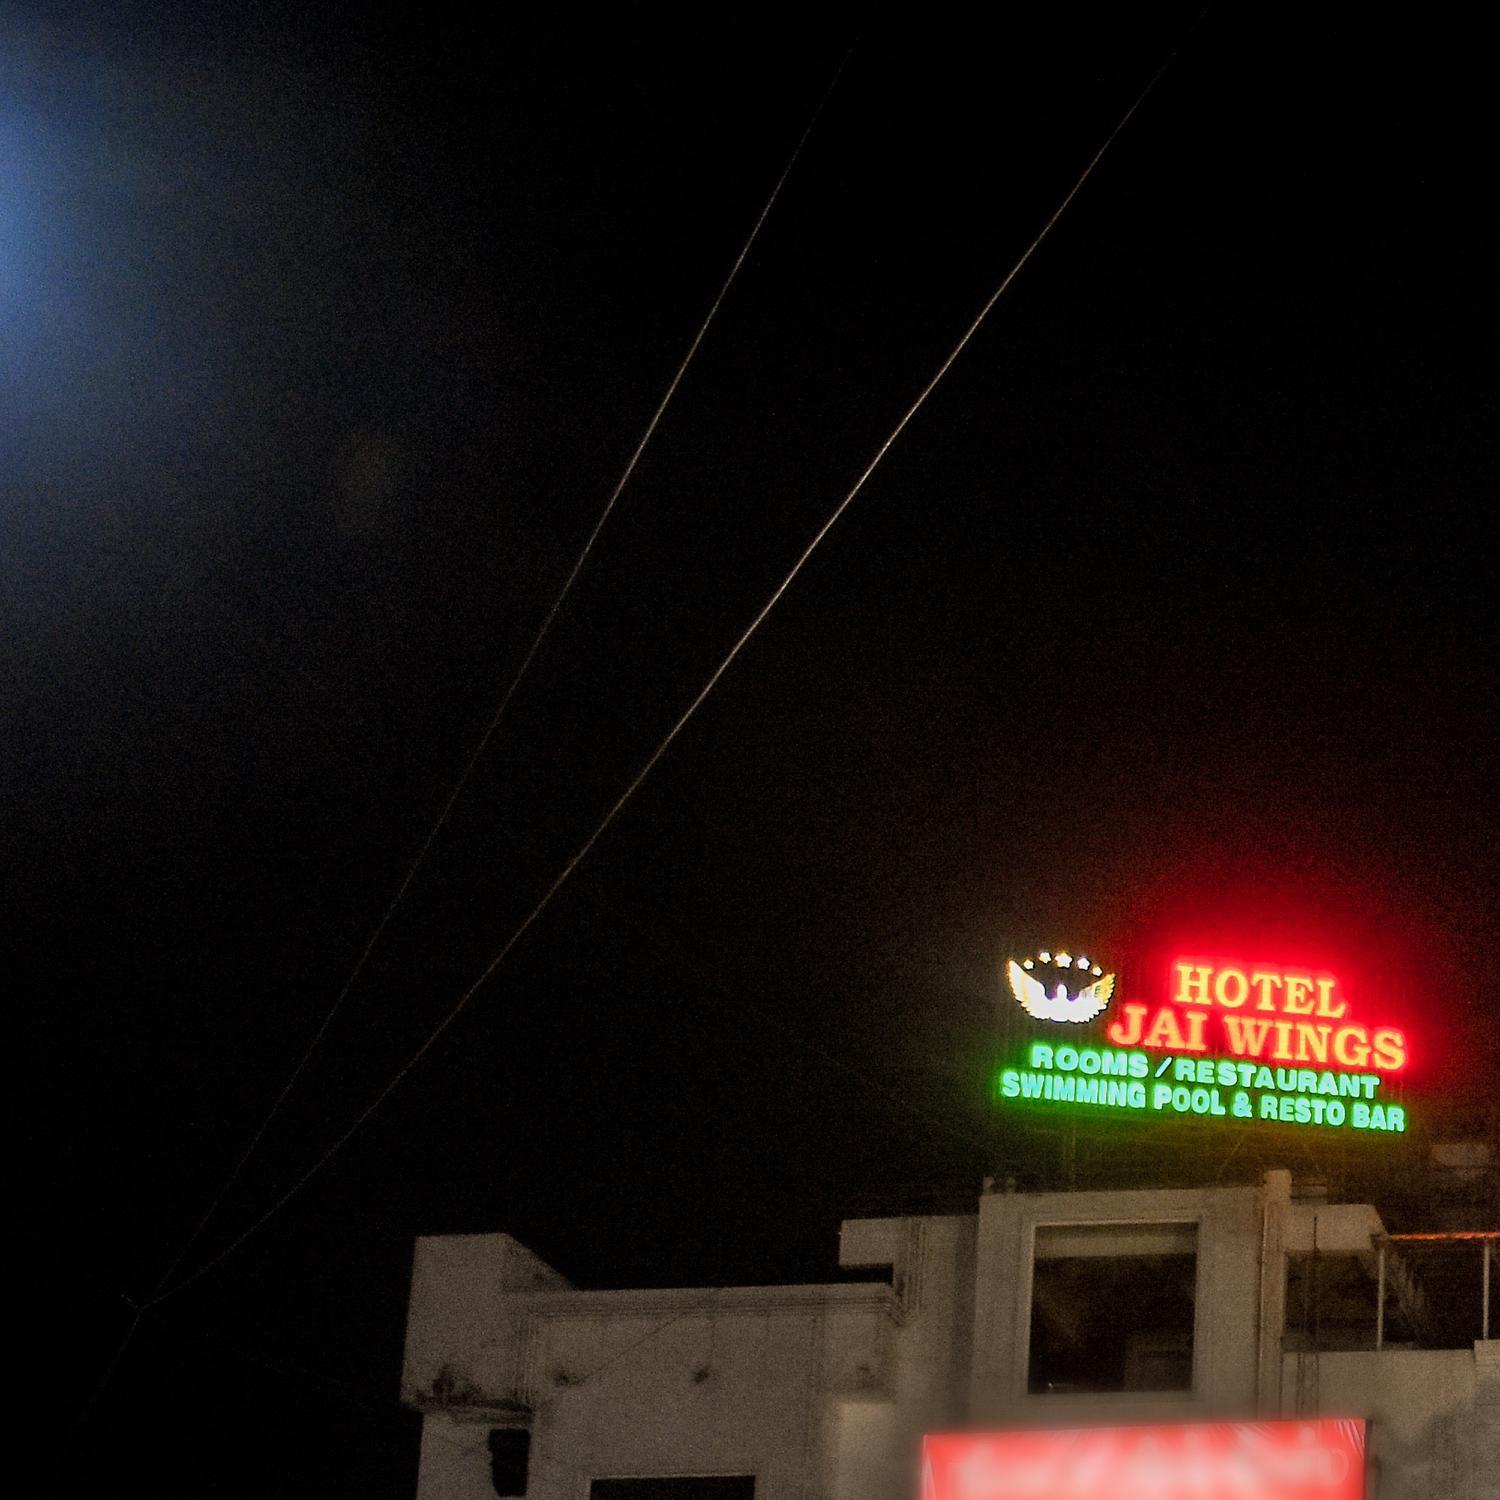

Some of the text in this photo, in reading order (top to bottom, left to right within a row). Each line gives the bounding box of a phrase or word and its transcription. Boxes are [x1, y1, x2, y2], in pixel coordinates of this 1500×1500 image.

[1176, 962, 1346, 1019] HOTEL
[1110, 1005, 1406, 1071] JAI WINGS
[1031, 1045, 1150, 1079] ROOMS
[1176, 1059, 1381, 1100] RESTAURANT
[1001, 1072, 1406, 1133] SWIMMING POOL & RESTO BAR
